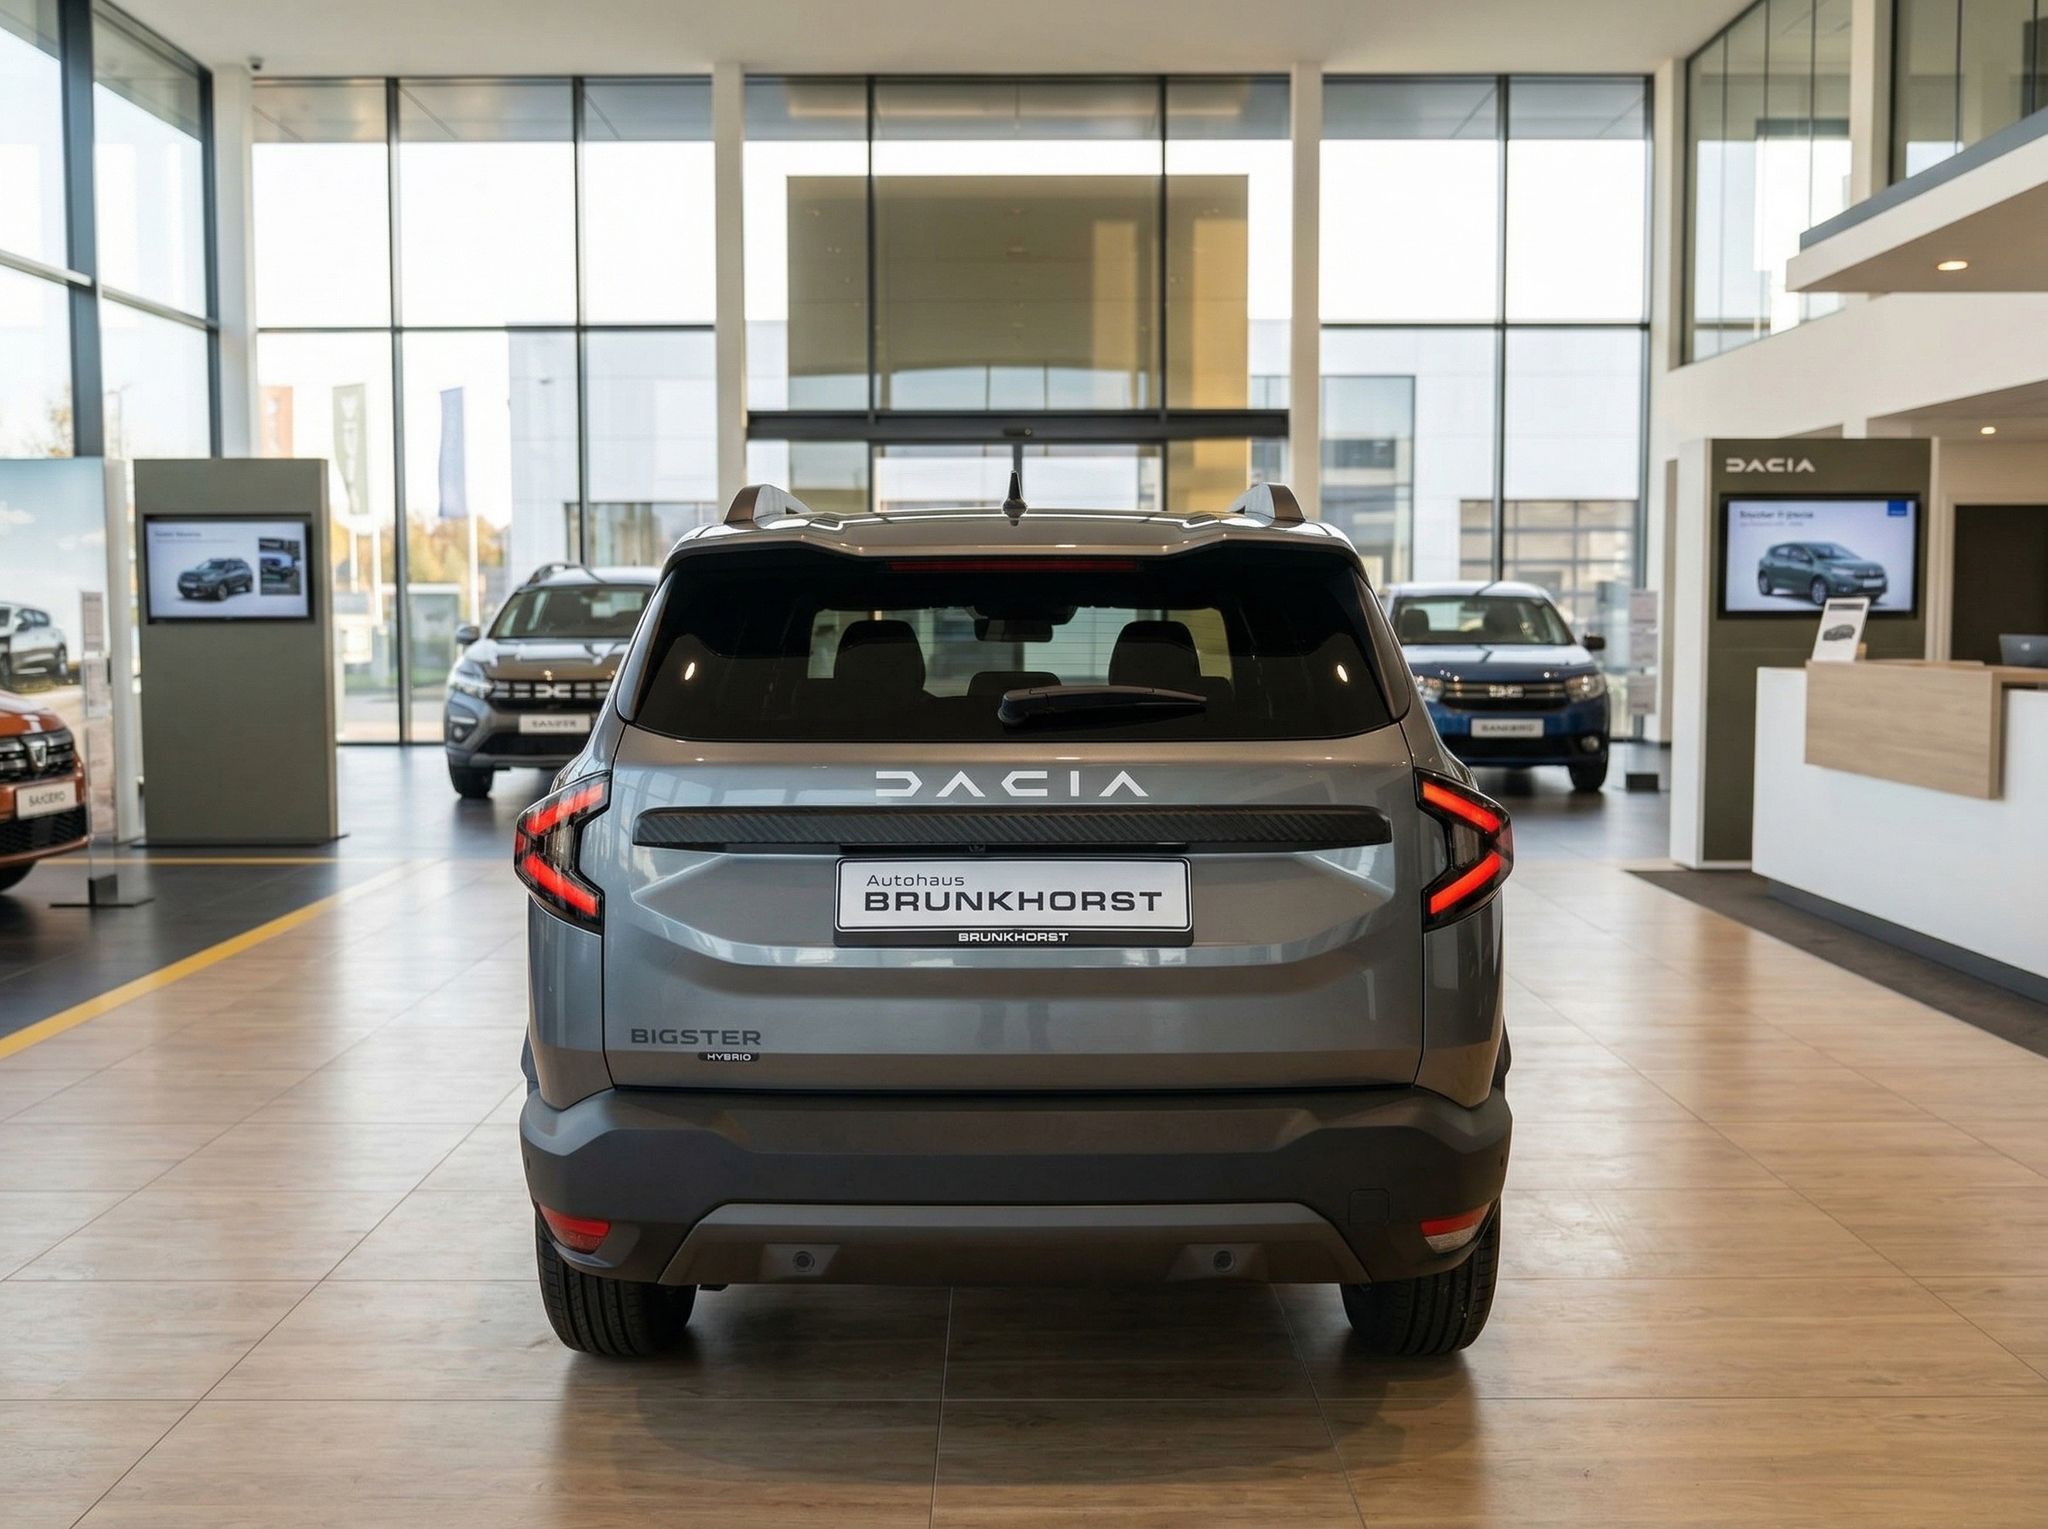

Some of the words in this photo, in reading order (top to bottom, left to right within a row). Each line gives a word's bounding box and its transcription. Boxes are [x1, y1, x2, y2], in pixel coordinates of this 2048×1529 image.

[1726, 457, 1816, 473] DACIA
[875, 770, 1149, 797] DACIA
[866, 874, 965, 887] Autohaus
[864, 891, 1162, 912] BRUNKHORST
[958, 932, 1069, 942] BRUNKHORST
[631, 1028, 761, 1046] BIGSTER
